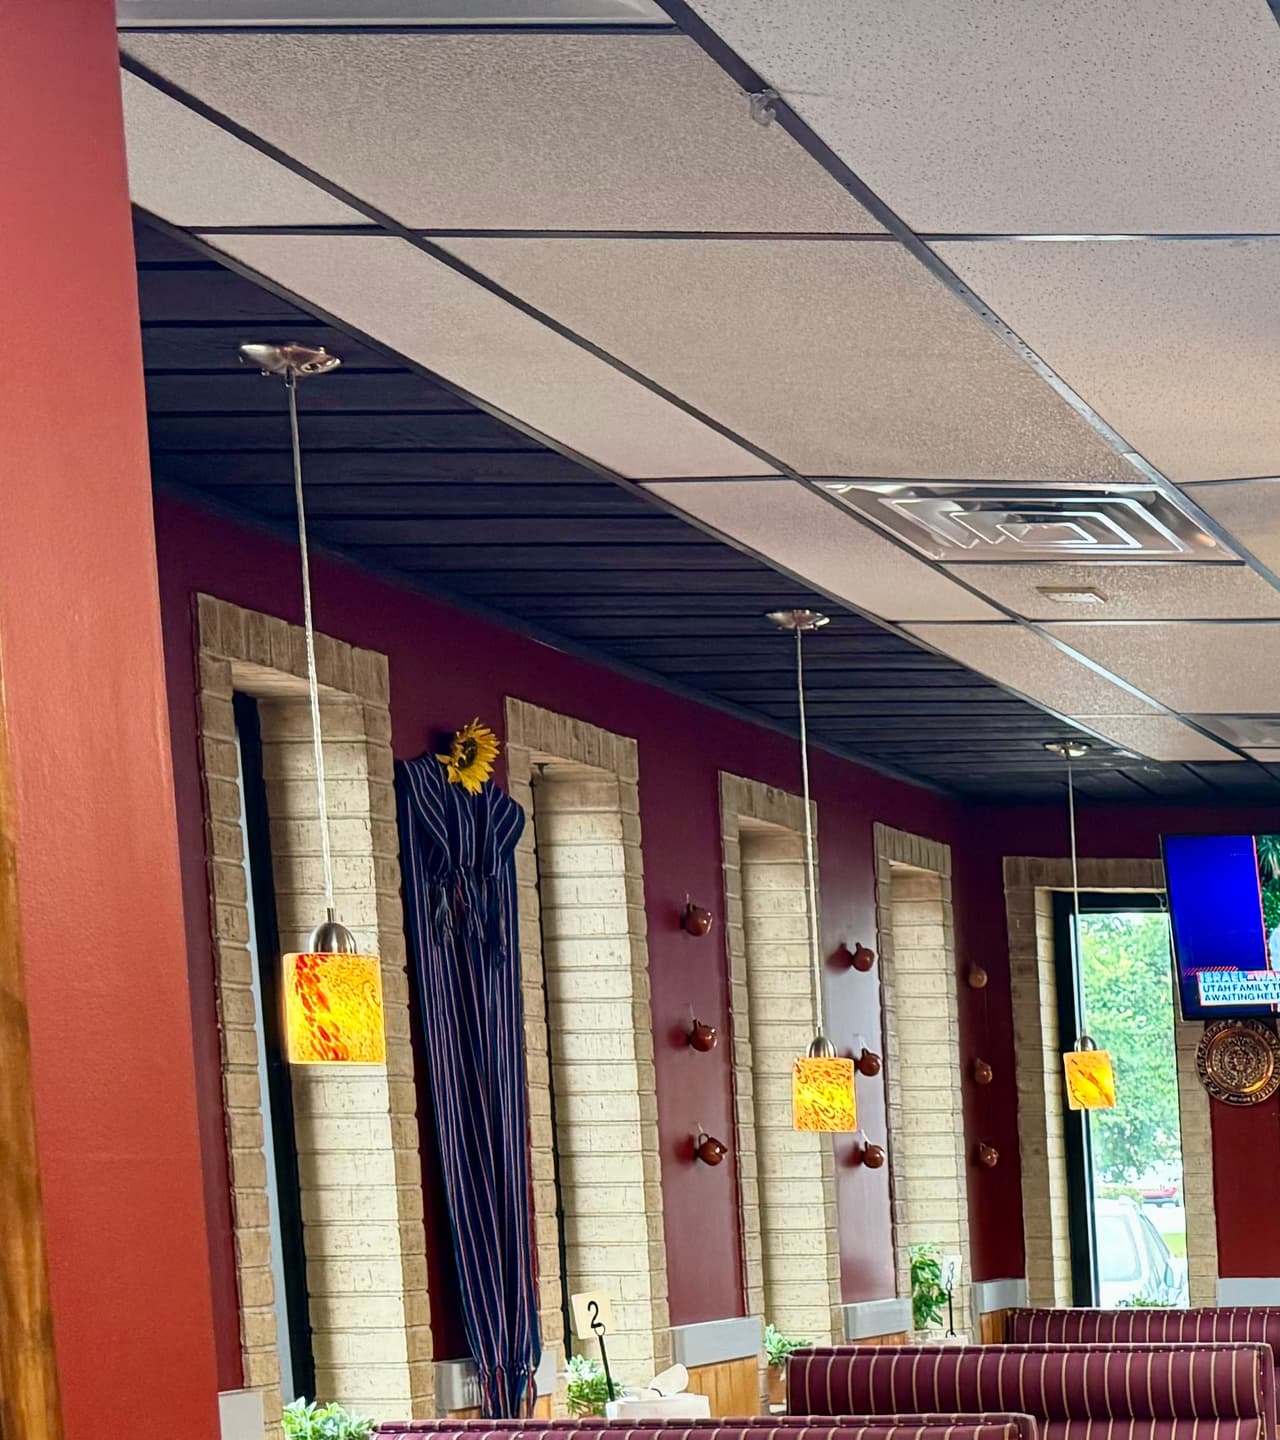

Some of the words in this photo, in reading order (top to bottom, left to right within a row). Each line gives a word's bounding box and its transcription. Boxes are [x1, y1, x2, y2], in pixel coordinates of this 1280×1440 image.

[1203, 983, 1231, 993] UTAH
[1233, 983, 1269, 992] FAMILY
[1205, 992, 1255, 1001] AWAITING
[587, 1300, 602, 1329] 2
